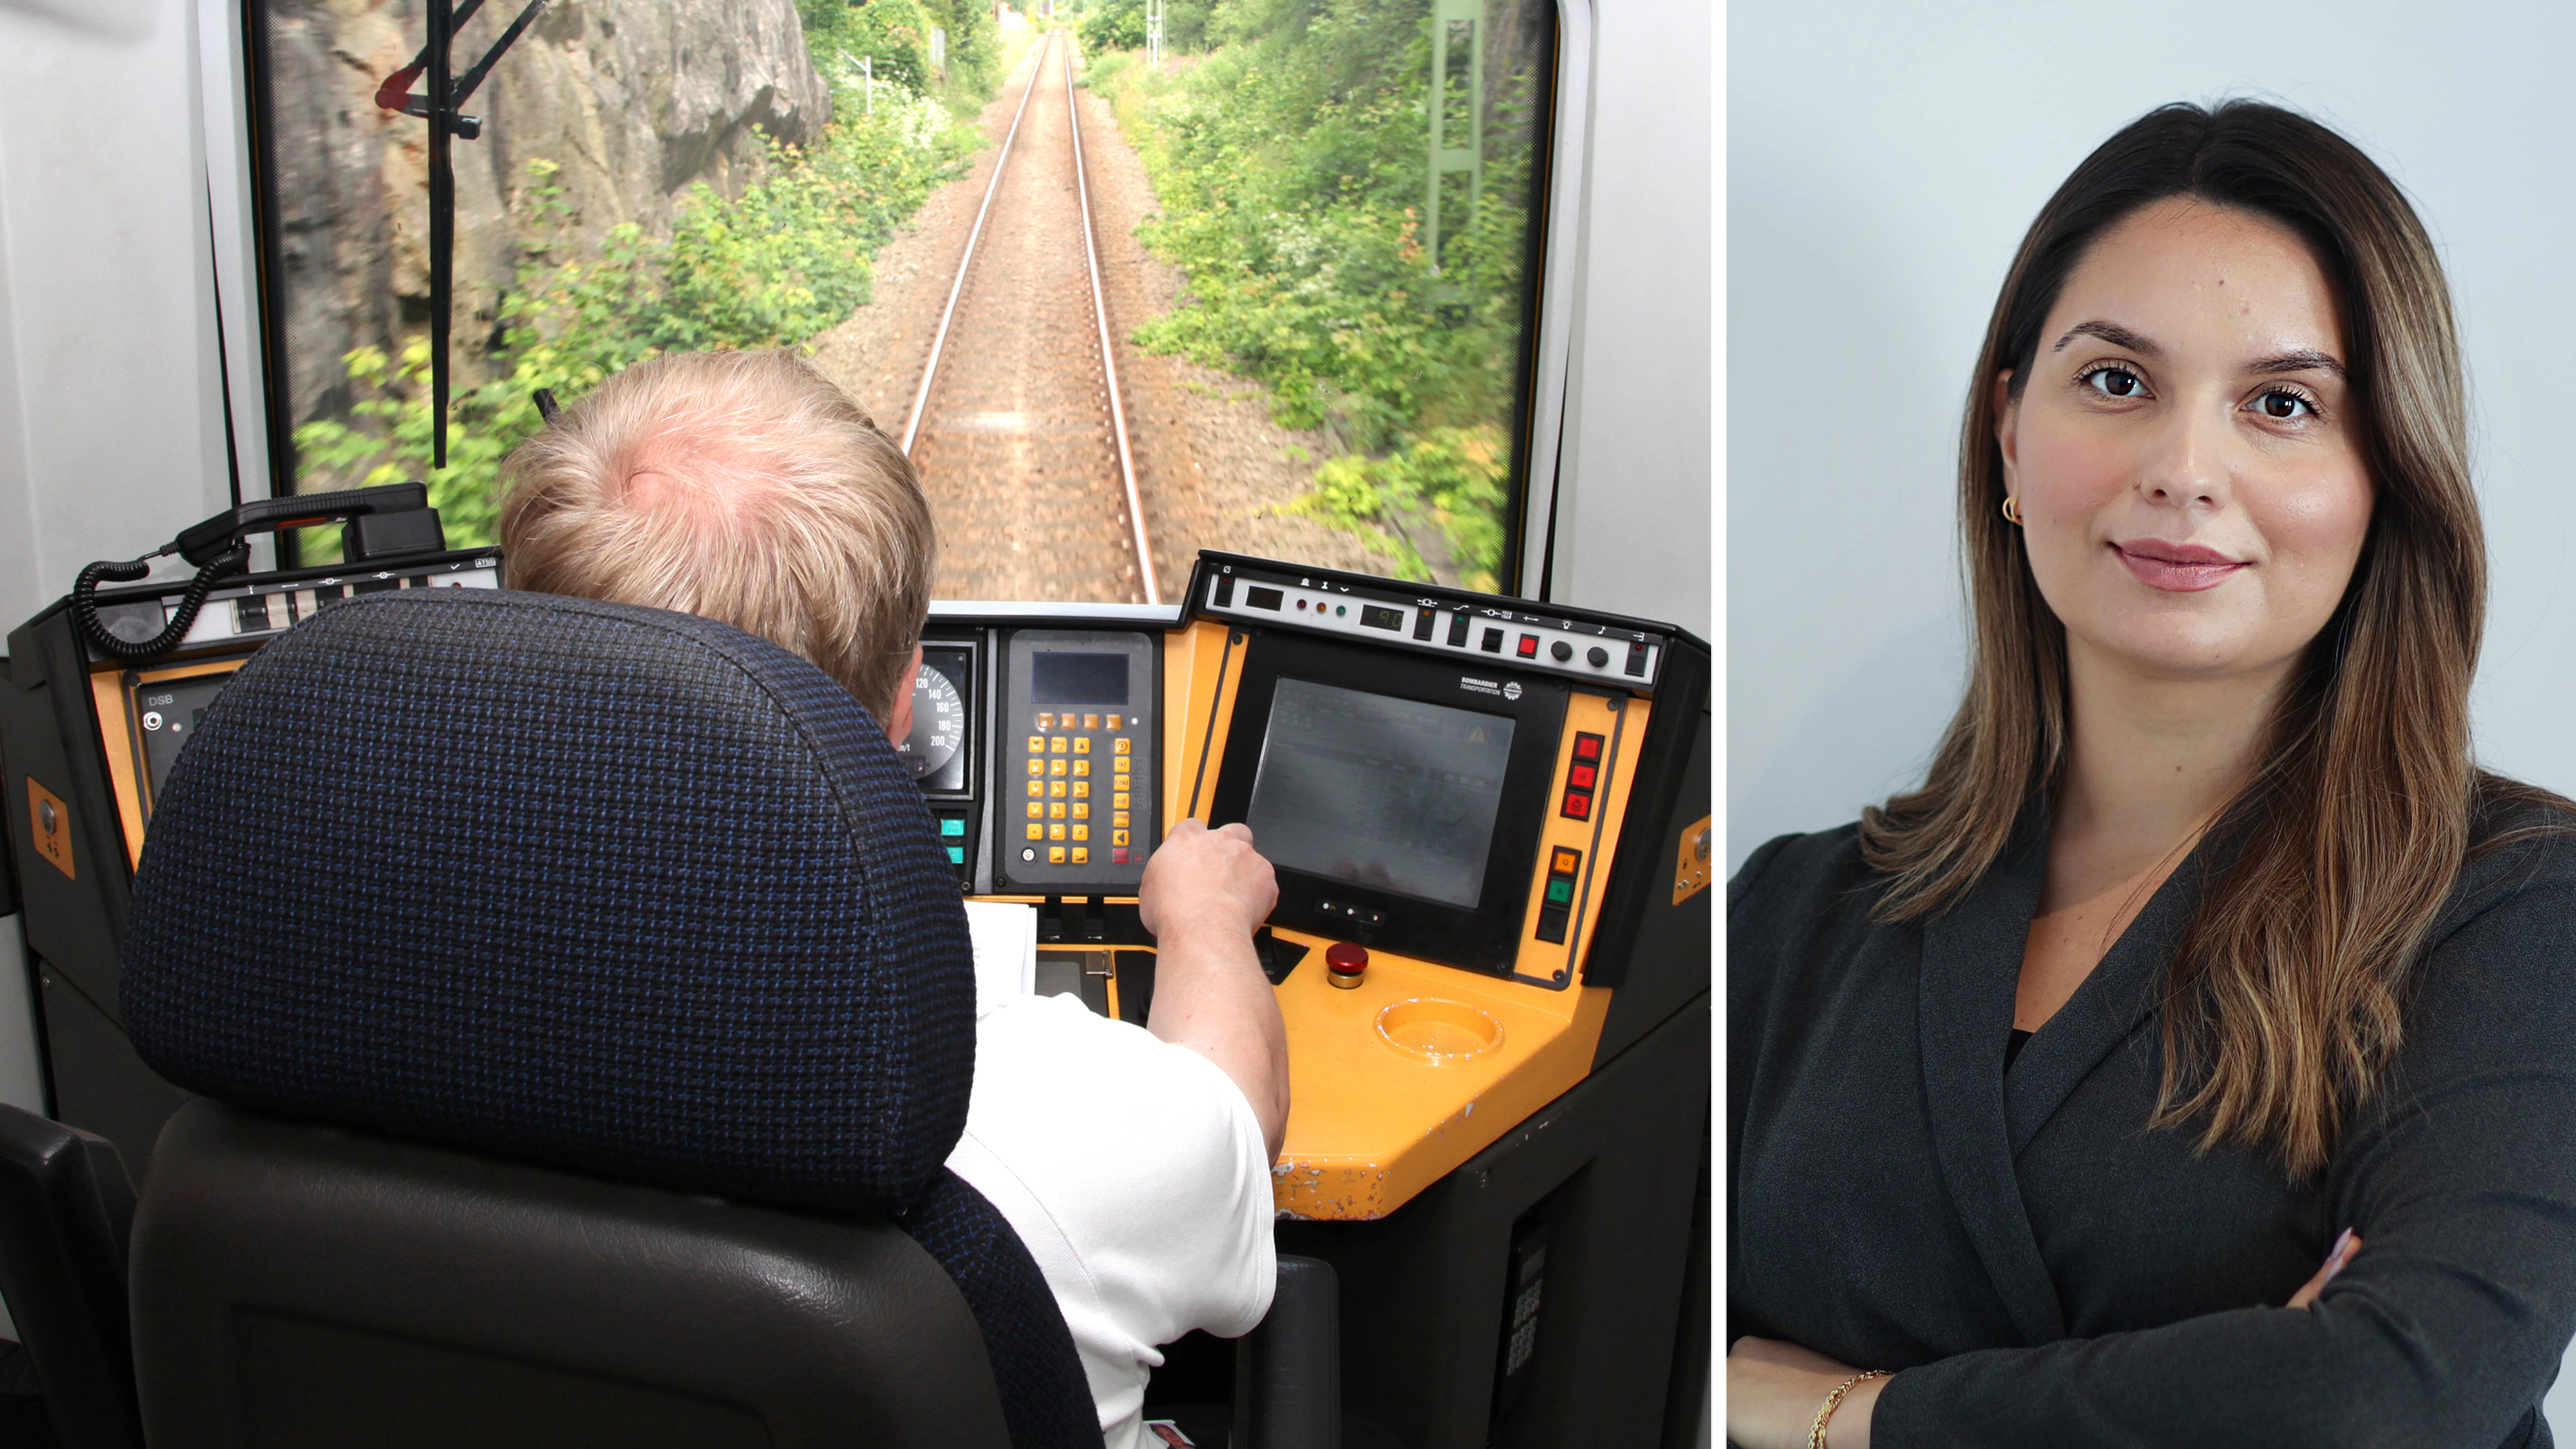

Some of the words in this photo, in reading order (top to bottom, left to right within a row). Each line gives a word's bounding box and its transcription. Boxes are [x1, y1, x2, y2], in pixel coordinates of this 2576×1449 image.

[1380, 611, 1403, 627] 90
[916, 678, 928, 688] 120
[1461, 677, 1498, 688] BOMBARDIER
[929, 689, 942, 699] 140
[1459, 683, 1501, 696] TRANSPORTATION
[149, 695, 173, 706] DSB
[936, 703, 949, 713] 160
[938, 721, 951, 731] 180
[931, 735, 945, 746] 200
[898, 744, 910, 752] m/t
